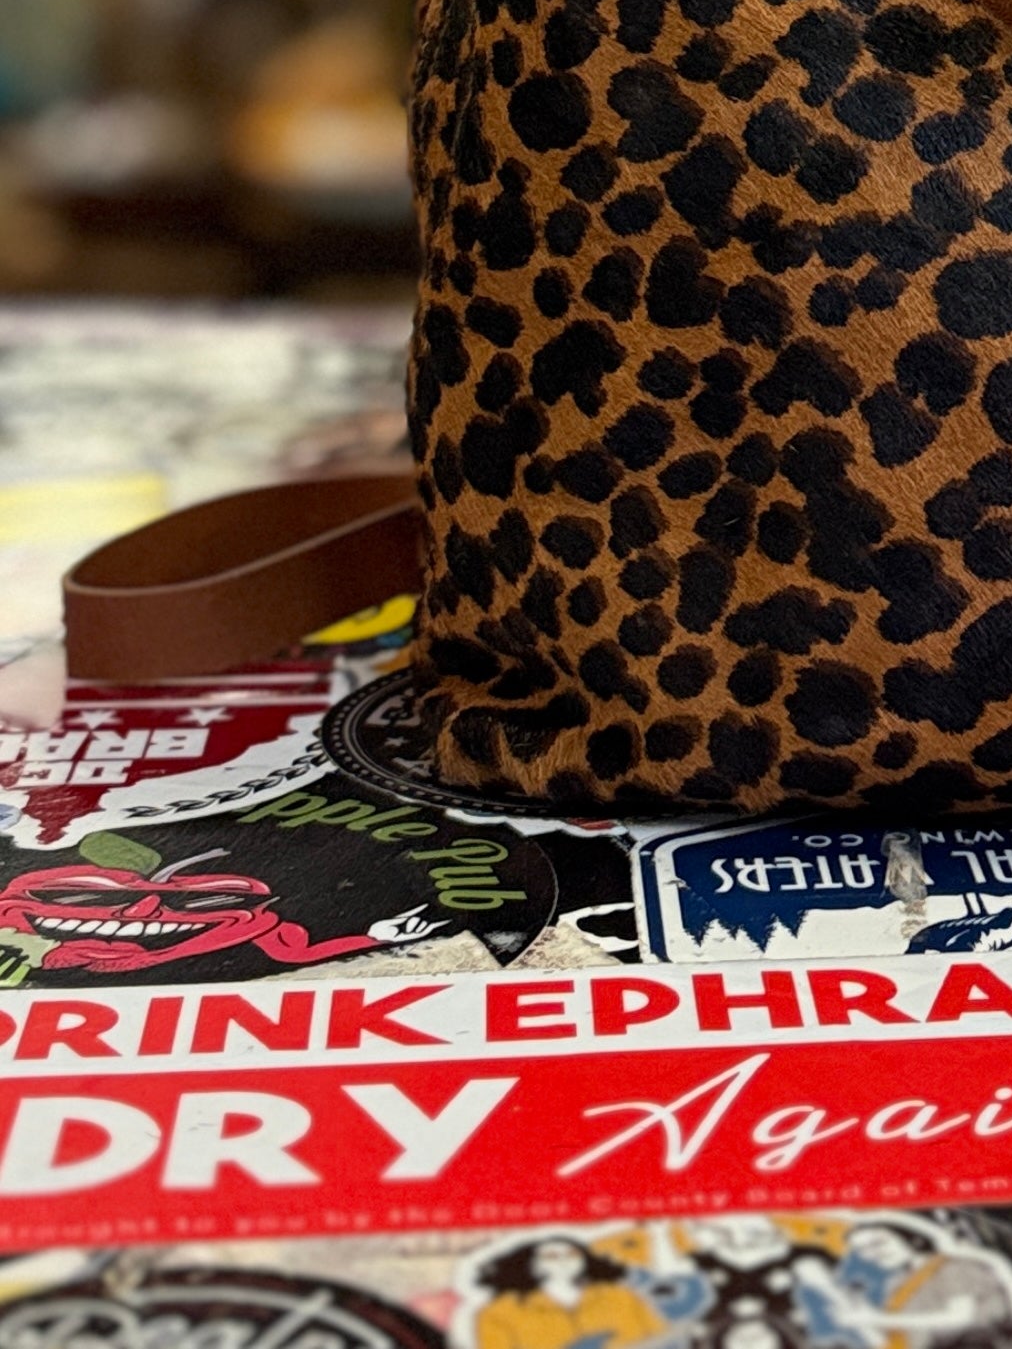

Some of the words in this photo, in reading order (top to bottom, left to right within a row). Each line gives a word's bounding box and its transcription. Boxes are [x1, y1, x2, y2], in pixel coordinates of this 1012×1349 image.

[236, 791, 439, 843] pple
[411, 838, 529, 911] Pub
[791, 833, 864, 848] CO.
[0, 1078, 519, 1196] DRY
